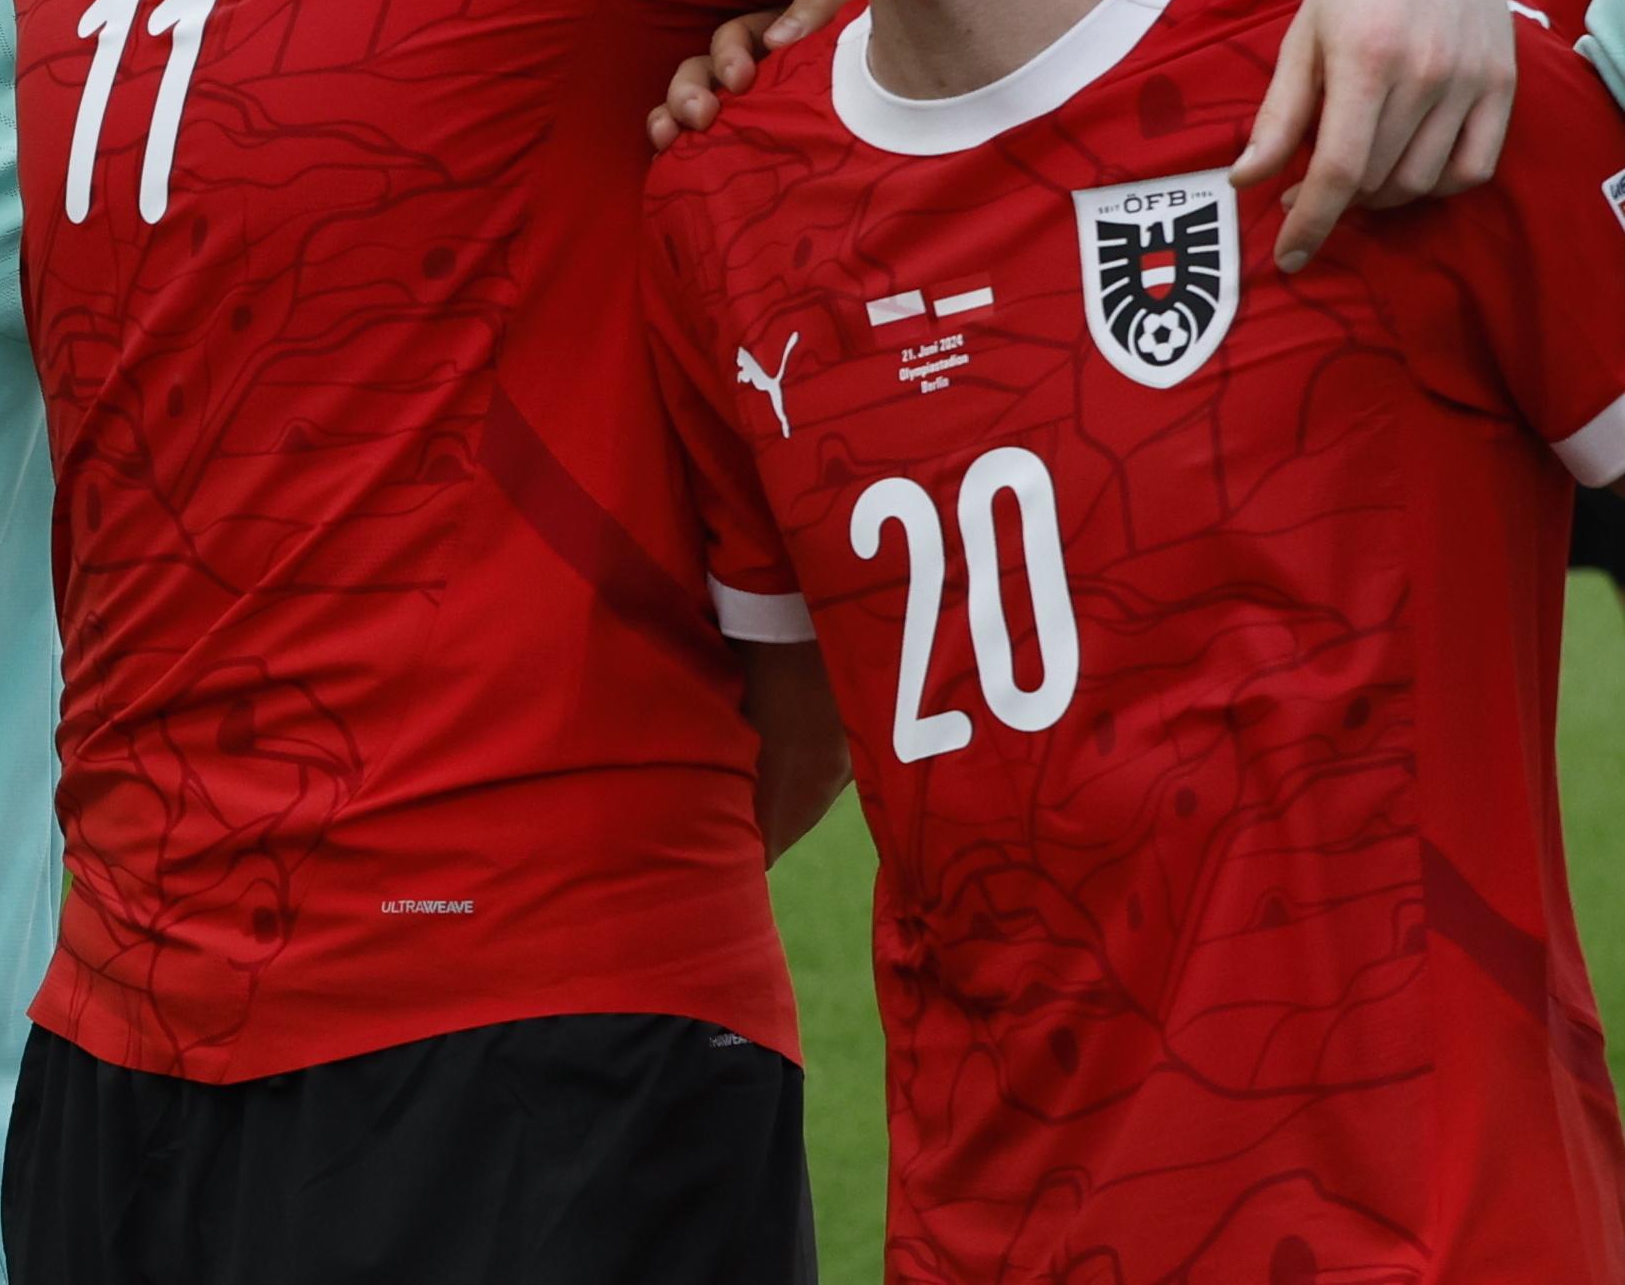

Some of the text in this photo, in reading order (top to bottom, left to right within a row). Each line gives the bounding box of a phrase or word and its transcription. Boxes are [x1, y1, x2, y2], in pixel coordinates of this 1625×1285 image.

[1123, 189, 1187, 213] ÖFB
[917, 340, 939, 358] Juni
[939, 333, 964, 352] 2024
[898, 354, 970, 382] Olympiastadion
[920, 375, 950, 394] Berlin
[849, 446, 1080, 764] 20
[381, 899, 474, 914] ULTRAWEAVE
